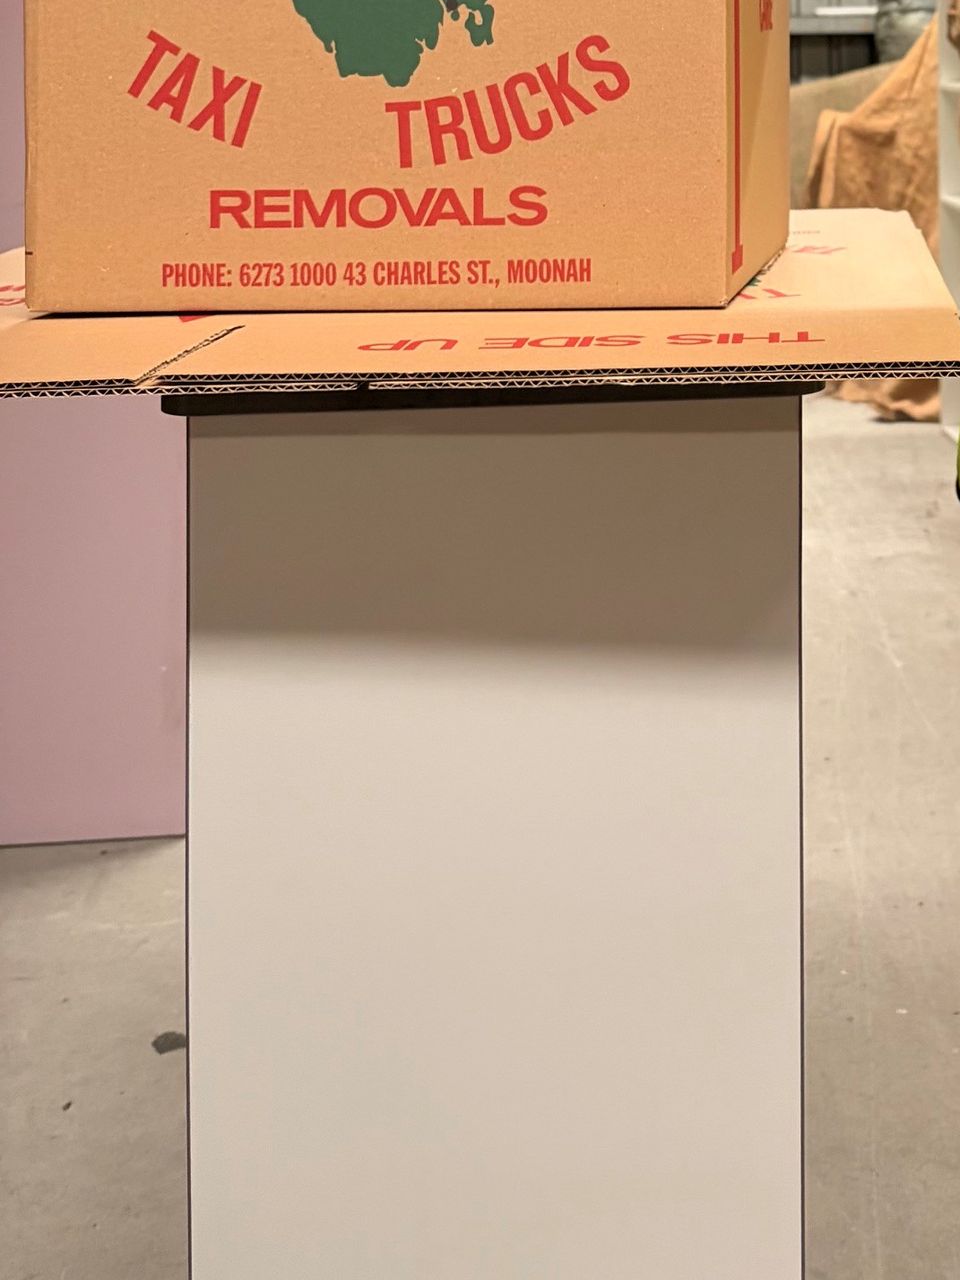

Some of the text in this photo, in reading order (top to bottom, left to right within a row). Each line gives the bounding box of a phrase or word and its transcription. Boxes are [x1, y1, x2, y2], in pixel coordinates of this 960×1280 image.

[126, 30, 632, 170] TAXI TRUCKS
[208, 184, 548, 231] REMOVALS
[161, 256, 592, 291] PHONE: 6273 1000 43 CHARLES ST., MOONAH
[357, 331, 826, 352] THIS SIDE UP
